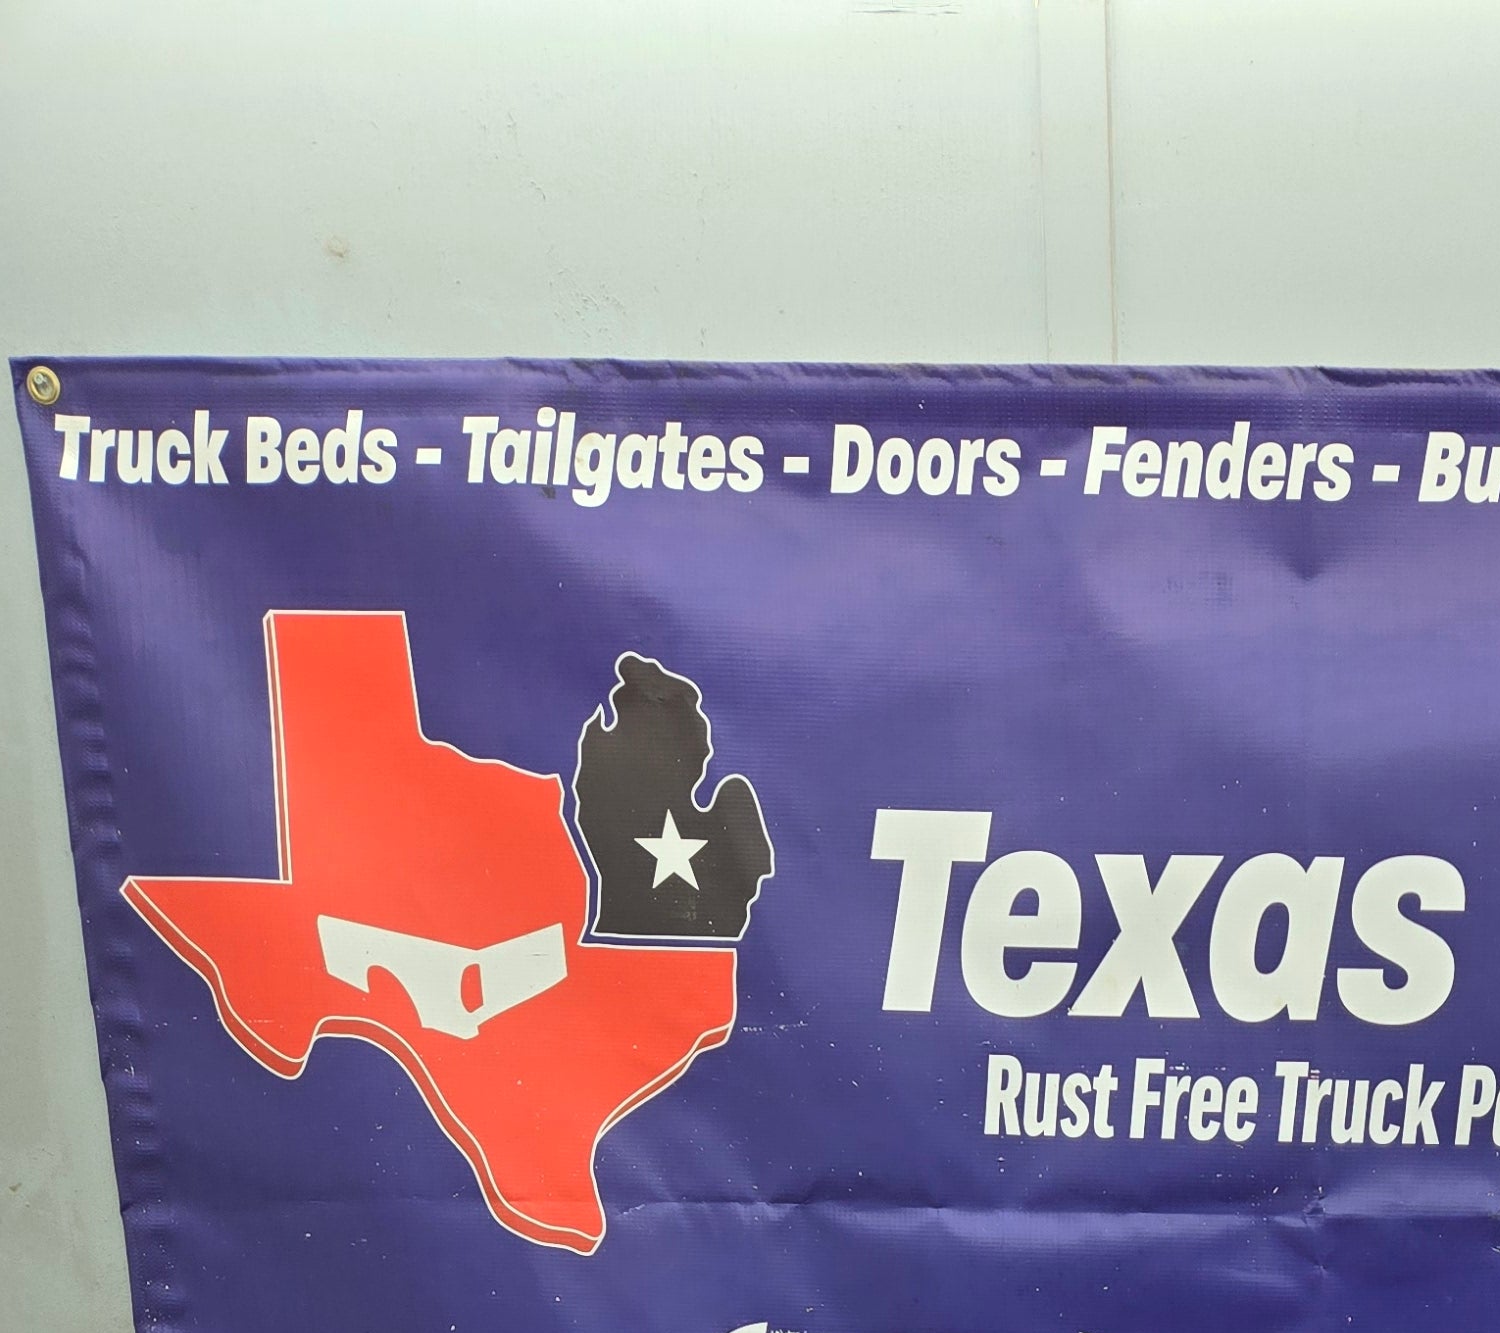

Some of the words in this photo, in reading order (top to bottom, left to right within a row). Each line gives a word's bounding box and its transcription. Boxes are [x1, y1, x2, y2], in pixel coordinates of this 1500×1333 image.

[54, 410, 229, 485] Truck
[247, 410, 397, 485] Beds
[415, 447, 443, 465] -
[461, 407, 764, 507] Tailgates
[782, 456, 810, 474] -
[830, 424, 1021, 497] Doors
[1039, 459, 1068, 477] -
[1083, 421, 1354, 501] Fenders
[1371, 464, 1401, 482] -
[870, 808, 1465, 1026] Texas
[983, 1054, 1118, 1139] Rust
[1129, 1057, 1258, 1142] Free
[1274, 1060, 1445, 1146] Truck
